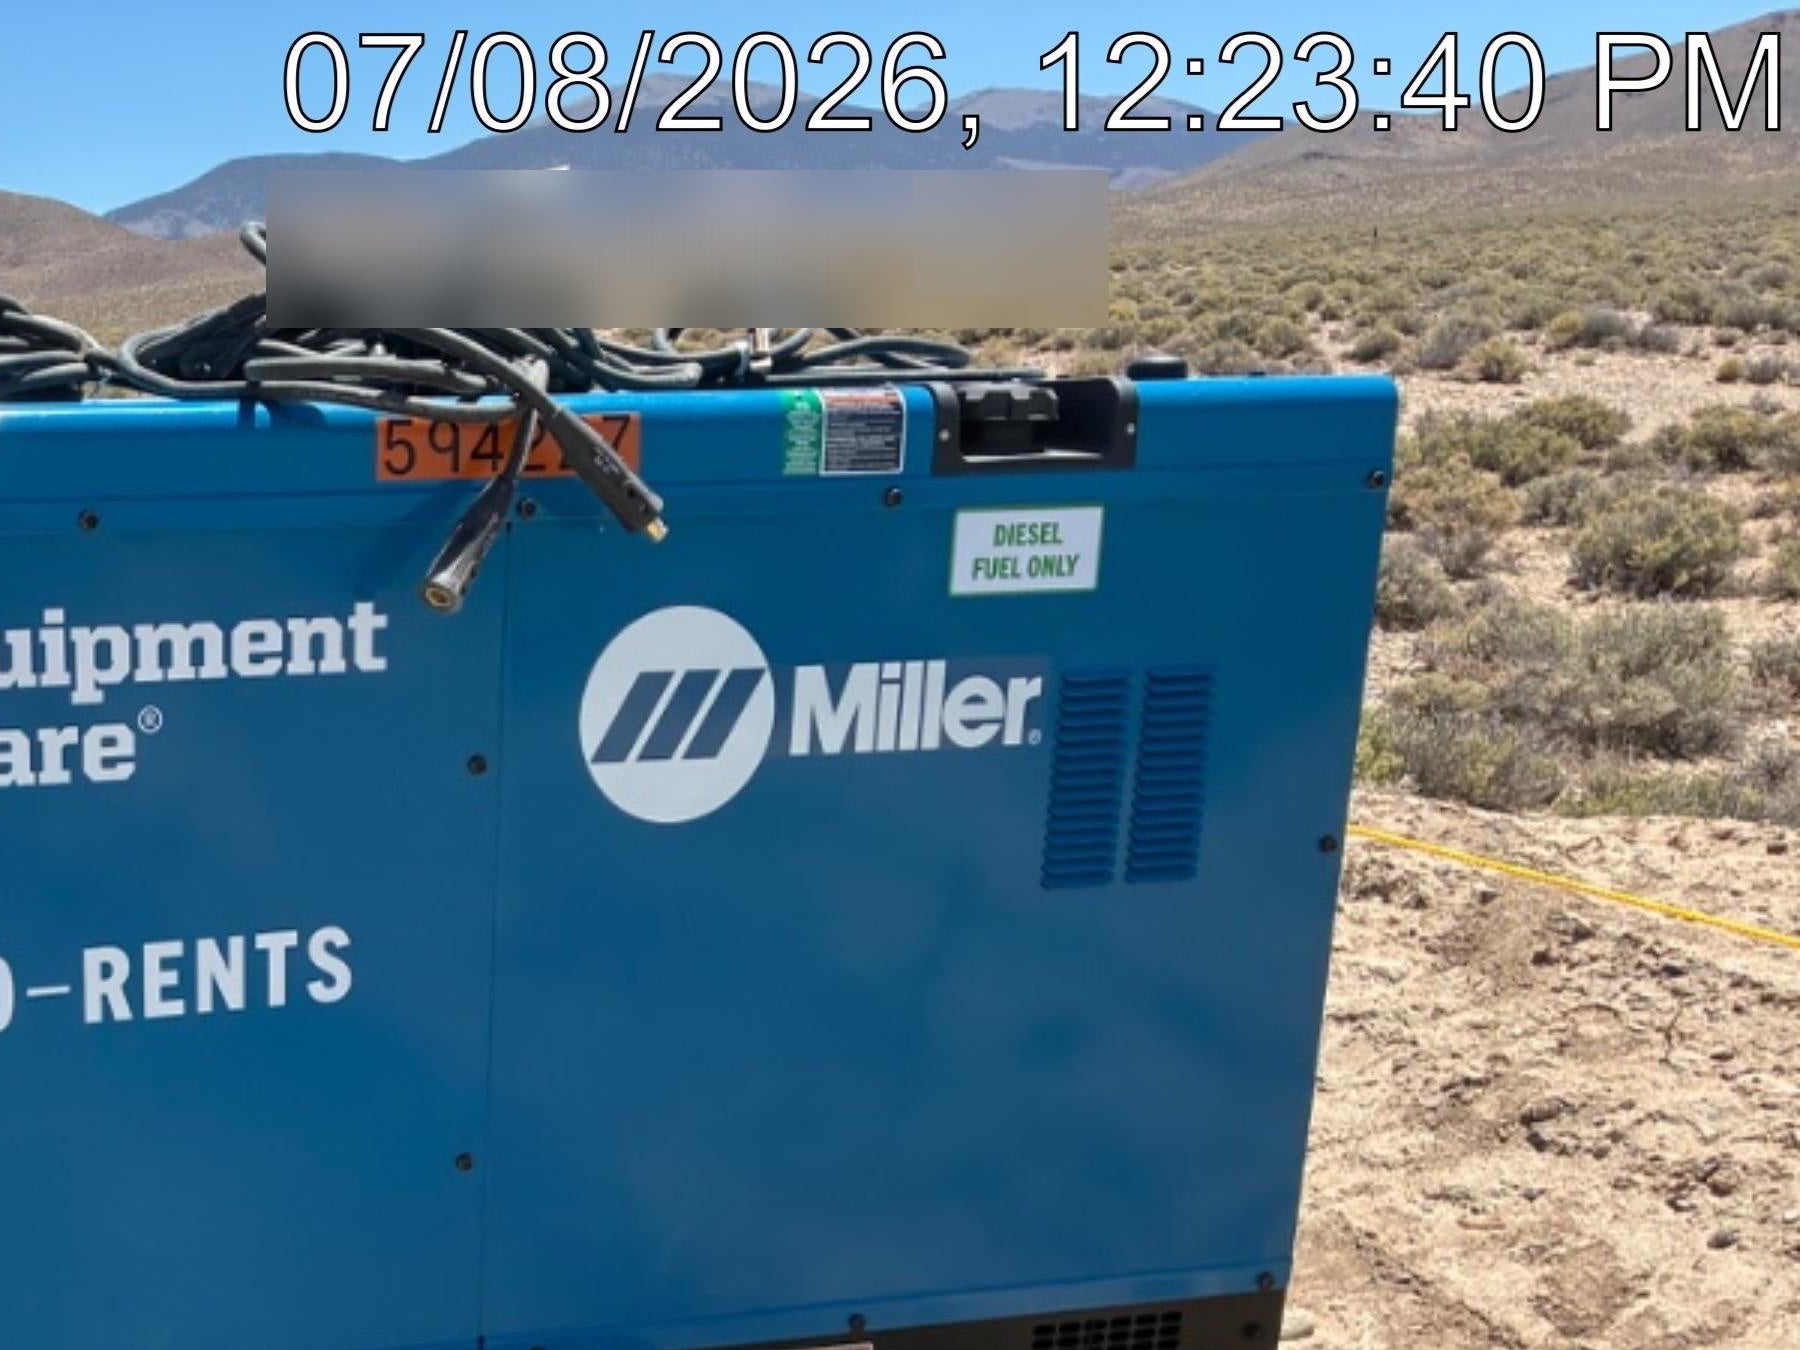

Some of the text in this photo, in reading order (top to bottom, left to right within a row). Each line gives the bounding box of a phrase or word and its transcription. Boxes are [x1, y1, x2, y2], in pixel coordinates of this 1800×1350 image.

[384, 413, 631, 474] 59427
[993, 522, 1063, 548] DIESEL
[971, 553, 1080, 581] FUEL ONLY
